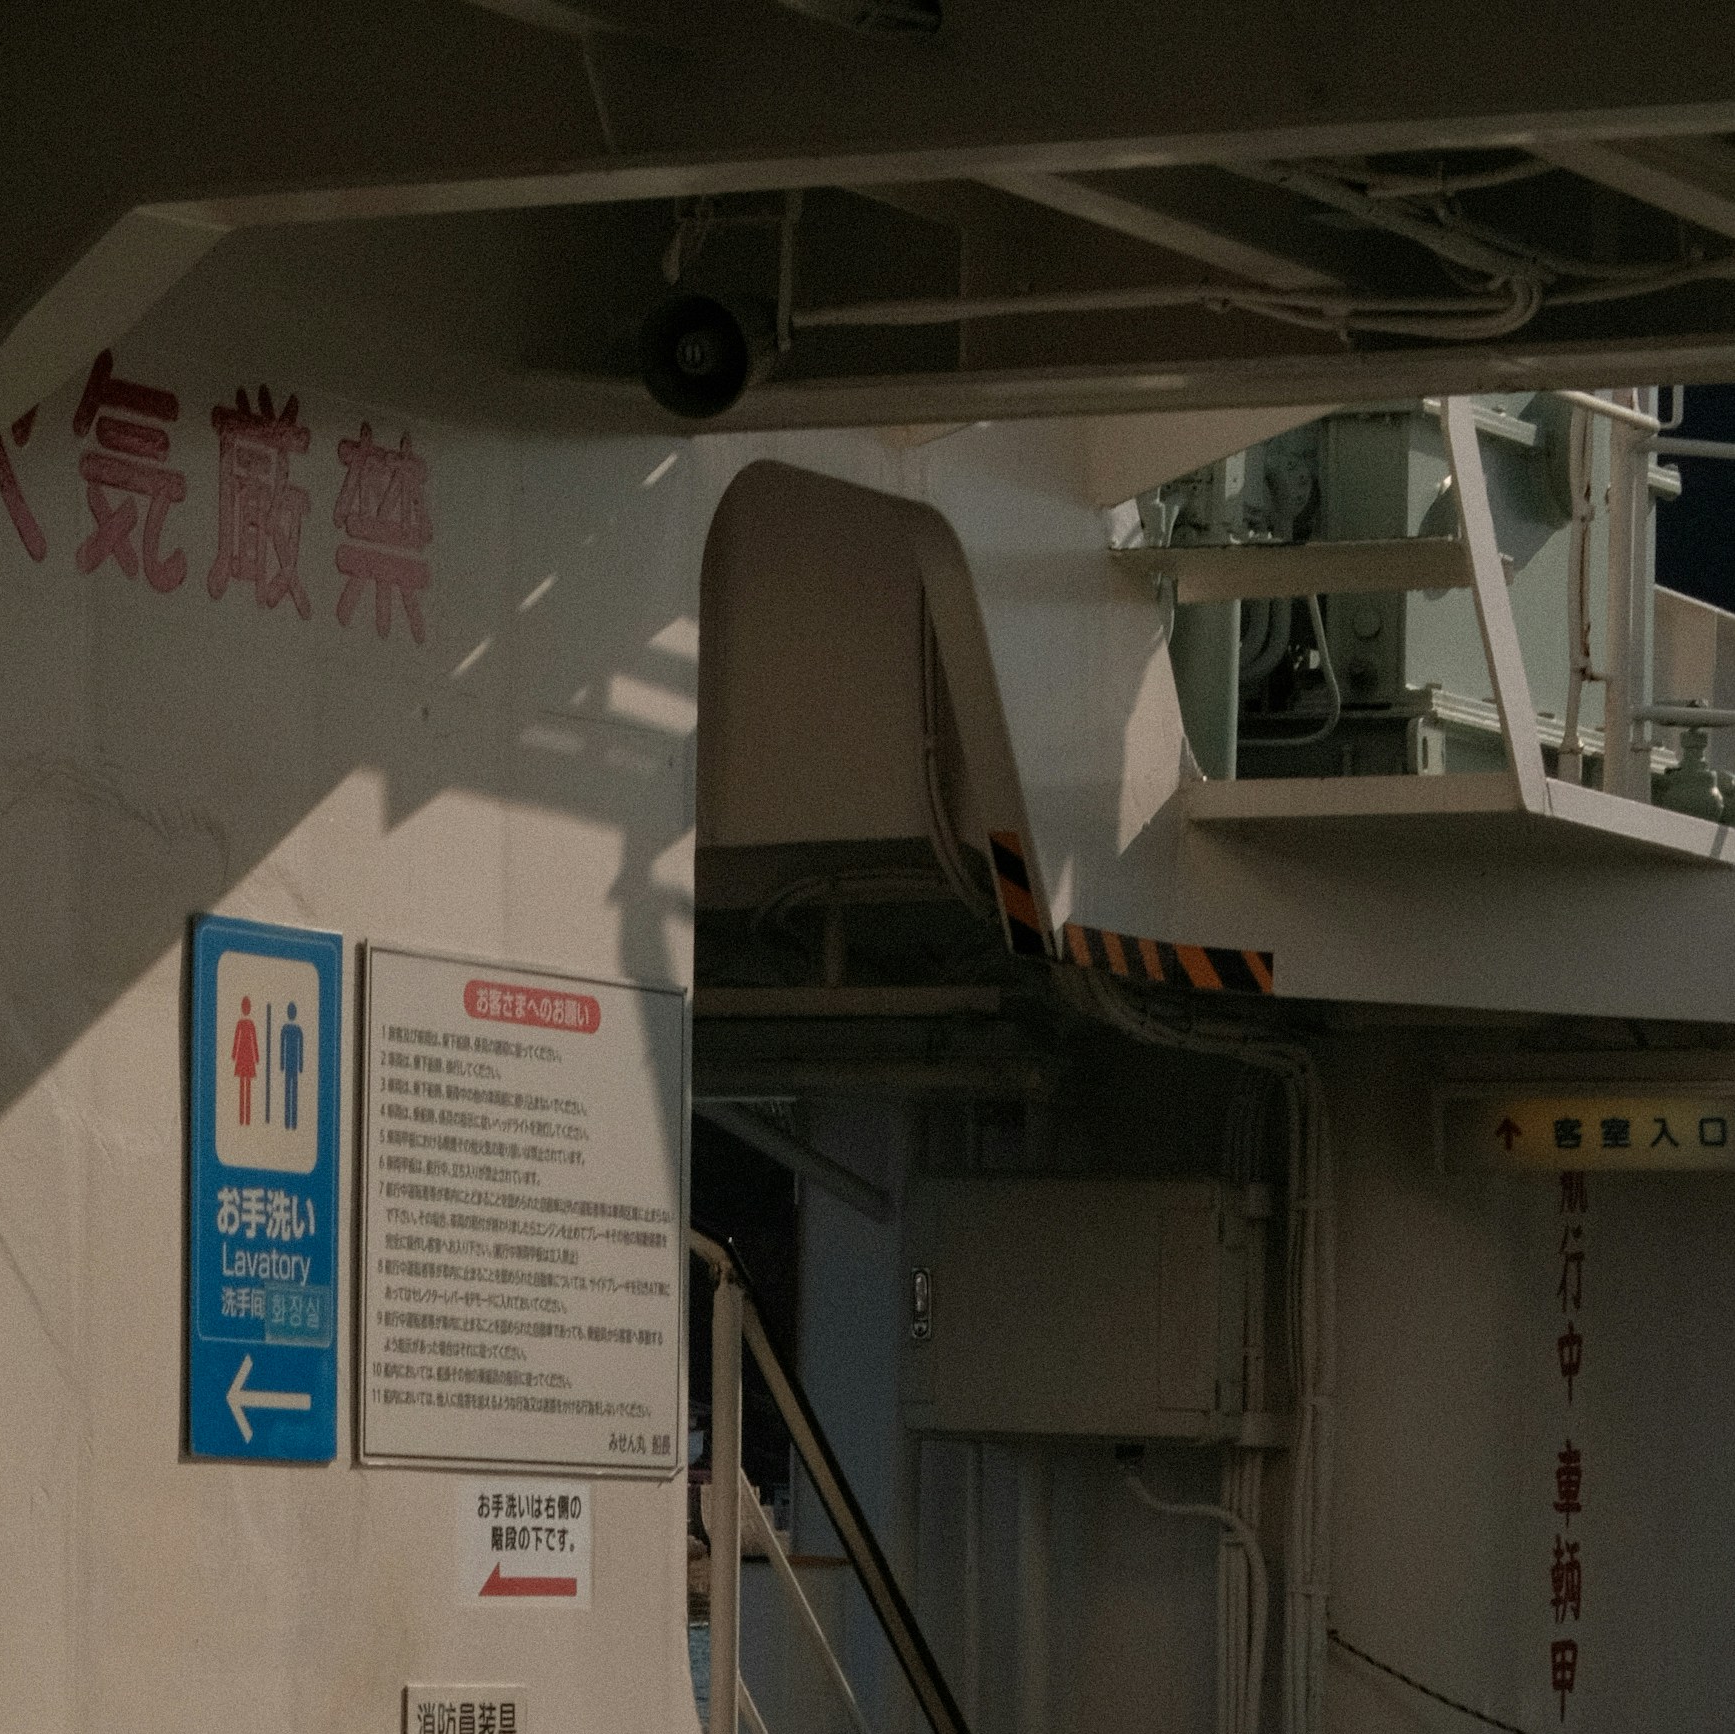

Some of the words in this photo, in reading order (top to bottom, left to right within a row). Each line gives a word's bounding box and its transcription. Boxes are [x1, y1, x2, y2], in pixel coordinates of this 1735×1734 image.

[475, 985, 589, 1029] お客さまへのお願い
[1553, 1117, 1728, 1149] 客室入口
[217, 1187, 316, 1241] お手洗い
[222, 1242, 311, 1287] Lavatory
[271, 1294, 320, 1329] 화장실
[477, 1493, 582, 1520] お手洗いは右側の
[491, 1526, 577, 1552] 階段の下です。
